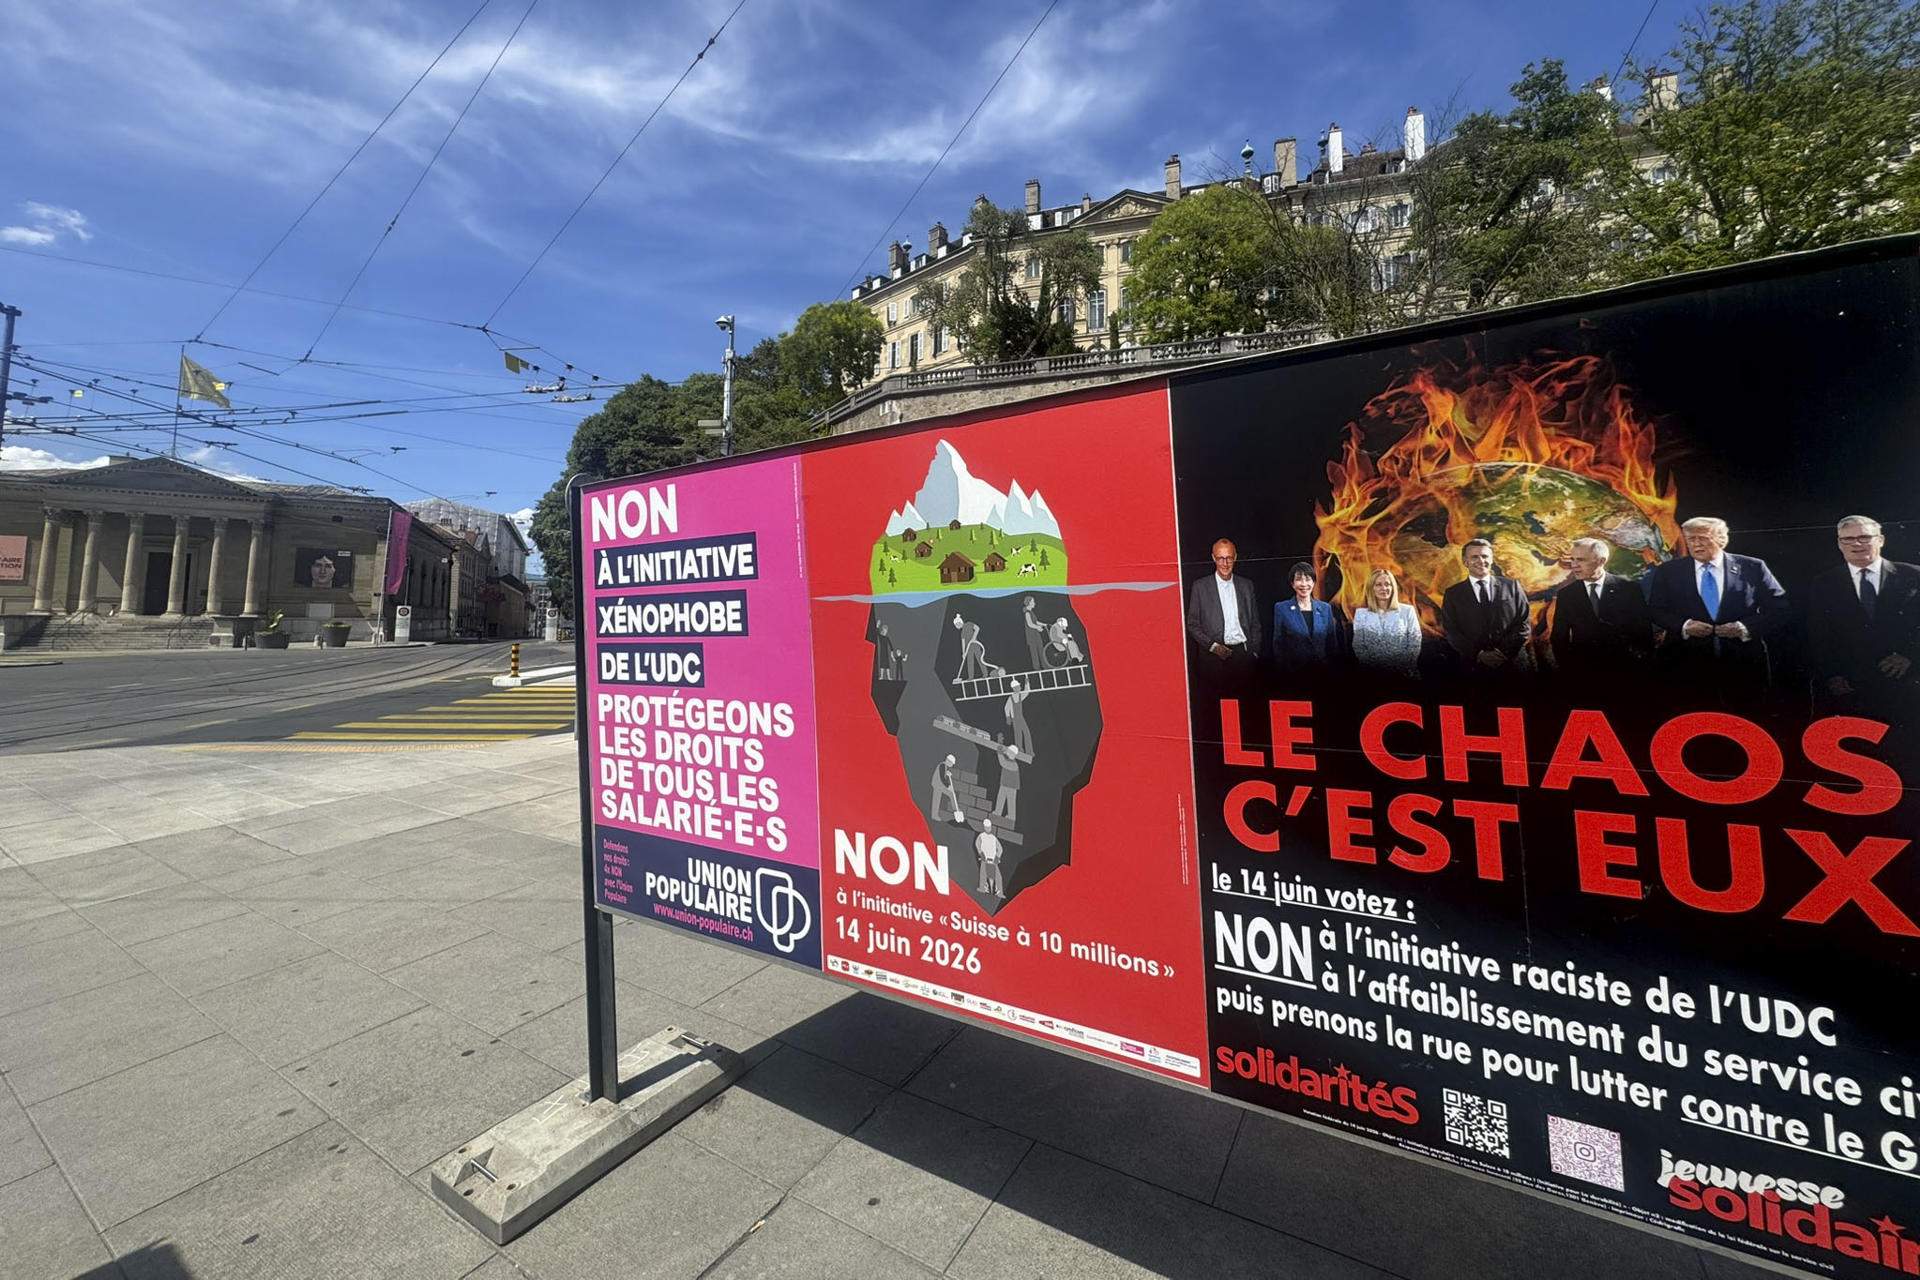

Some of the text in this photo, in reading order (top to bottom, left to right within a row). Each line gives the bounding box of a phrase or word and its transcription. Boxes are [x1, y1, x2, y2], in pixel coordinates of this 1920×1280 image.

[591, 483, 678, 542] NON
[598, 543, 754, 585] À L'INITIATIVE
[599, 598, 743, 634] XÉNOPHOBE
[601, 652, 701, 684] DE L'UDC
[598, 690, 795, 738] PROTÉGEONS
[599, 725, 765, 772] LES DROITS
[1220, 698, 1903, 816] LE CHAOS
[600, 757, 779, 812] DE TOUS LES
[688, 857, 752, 896] UNION
[835, 828, 950, 896] NON
[1223, 780, 1520, 881] C'EST
[1574, 809, 1920, 937] EUX
[645, 872, 753, 923] POPULAIRE
[1212, 862, 1231, 890] le
[1241, 868, 1267, 896] 14
[1273, 872, 1317, 906] juin
[1325, 888, 1398, 918] votez
[653, 902, 753, 942] www.union-populaire.ch
[836, 887, 848, 904] à
[853, 889, 933, 924] l'initiative
[1016, 926, 1031, 947] à
[1040, 931, 1062, 954] 10
[836, 915, 860, 943] 14
[867, 922, 911, 957] juin
[920, 935, 981, 975] 2026
[1214, 910, 1314, 982] NON
[1319, 919, 1837, 1047] à l'initiative raciste de l'UDC
[1321, 961, 1920, 1119] à l'affaiblissement du service ci
[1216, 984, 1264, 1015] puis
[1272, 999, 1378, 1043] prenons
[1385, 1014, 1413, 1051] la
[1422, 1034, 1472, 1065] rue
[1482, 1047, 1559, 1085] pour
[1569, 1055, 1667, 1111] lutter
[1681, 1095, 1810, 1147] contre
[1823, 1113, 1864, 1160] le
[1657, 1148, 1845, 1210] jeunesse
